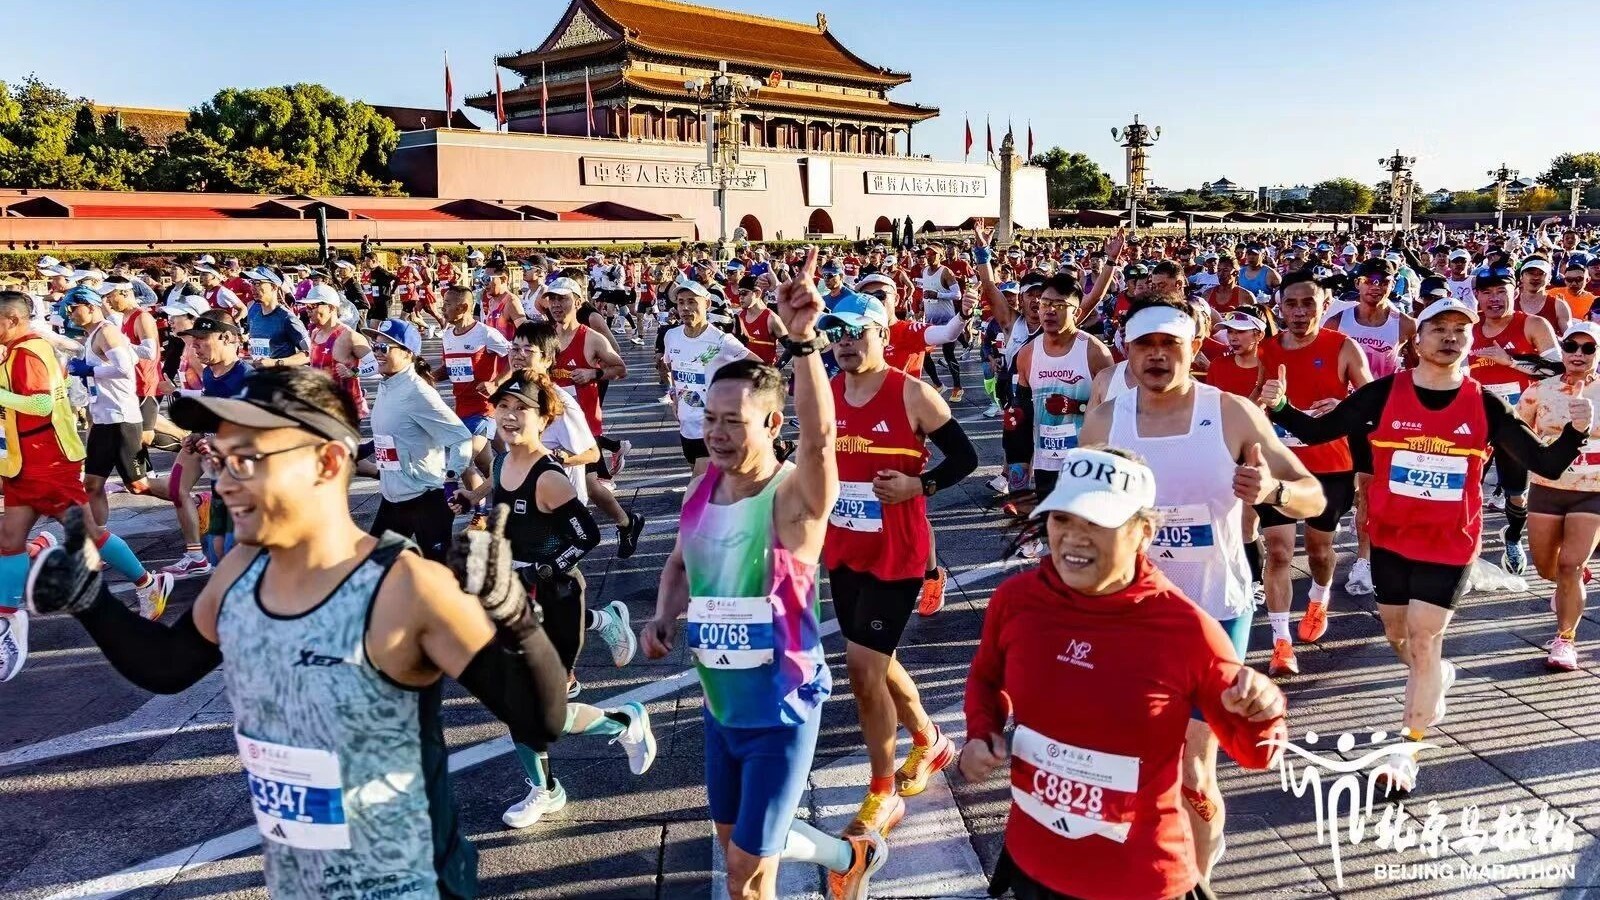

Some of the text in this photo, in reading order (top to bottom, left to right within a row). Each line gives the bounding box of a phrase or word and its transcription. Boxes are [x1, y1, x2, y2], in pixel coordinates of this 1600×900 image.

[677, 371, 697, 382] C1700
[1038, 370, 1074, 379] saucony
[836, 437, 868, 454] BEIJING
[1044, 437, 1066, 449] C1877
[1409, 438, 1449, 455] BEIJING
[1407, 469, 1449, 486] C2261
[699, 623, 750, 645] C0768
[1032, 769, 1103, 813] C8828
